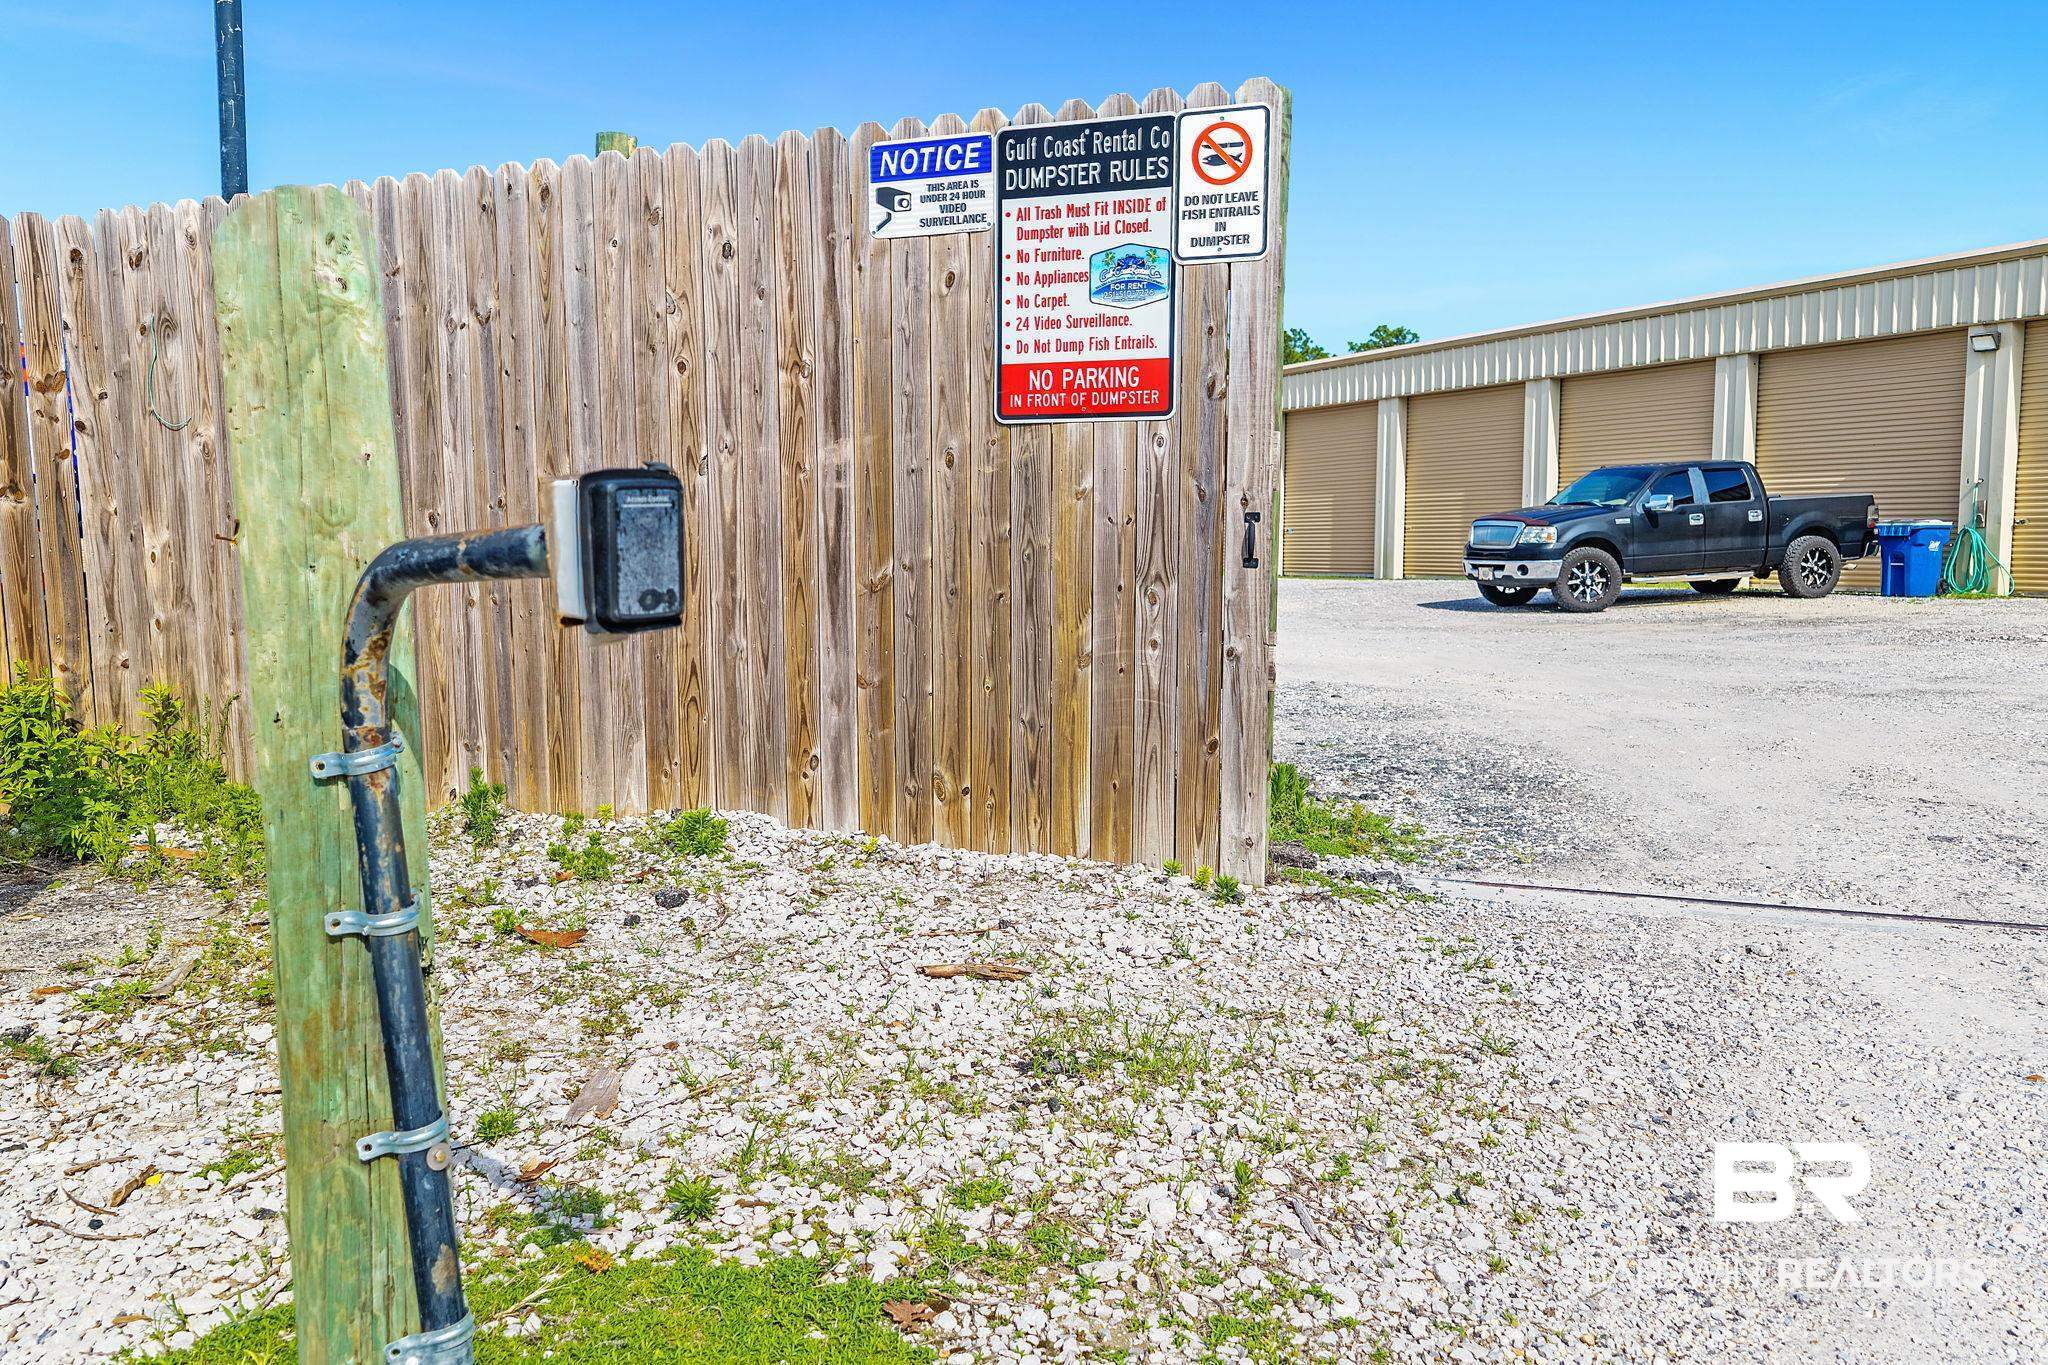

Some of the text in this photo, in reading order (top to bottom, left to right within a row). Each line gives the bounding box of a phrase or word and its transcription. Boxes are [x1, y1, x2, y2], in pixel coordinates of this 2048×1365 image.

[1006, 126, 1170, 161] Gulf Coast Rental Co
[880, 142, 982, 176] NOTICE
[1006, 156, 1169, 190] DUMPSTER RULES
[926, 180, 979, 192] THIS AREA IS
[920, 190, 986, 203] UNDER 24 HOUR
[1184, 191, 1258, 206] DO NOT LEAVE
[939, 203, 967, 213] VIDEO
[1016, 196, 1167, 221] All Trash Must Fit INSIDE of
[1182, 205, 1260, 220] FISH ENTRAILS
[919, 213, 987, 227] SURVEILLANCE
[1215, 222, 1226, 232] IN
[1017, 218, 1152, 242] Dumpster with Lid Closed.
[1190, 234, 1250, 247] DUMPSTER
[1016, 247, 1084, 263] No Furniture.
[1016, 272, 1030, 286] No
[1034, 270, 1088, 288] Appliances
[1128, 282, 1147, 290] RENT
[1016, 293, 1070, 310] No Carpet.
[1016, 313, 1132, 331] 24 Video Surveillance.
[1016, 335, 1157, 355] Do Not Dump Fish Entrails.
[1029, 366, 1140, 390] NO PARKING
[1010, 390, 1159, 408] IN FRONT OF DUMPSTER
